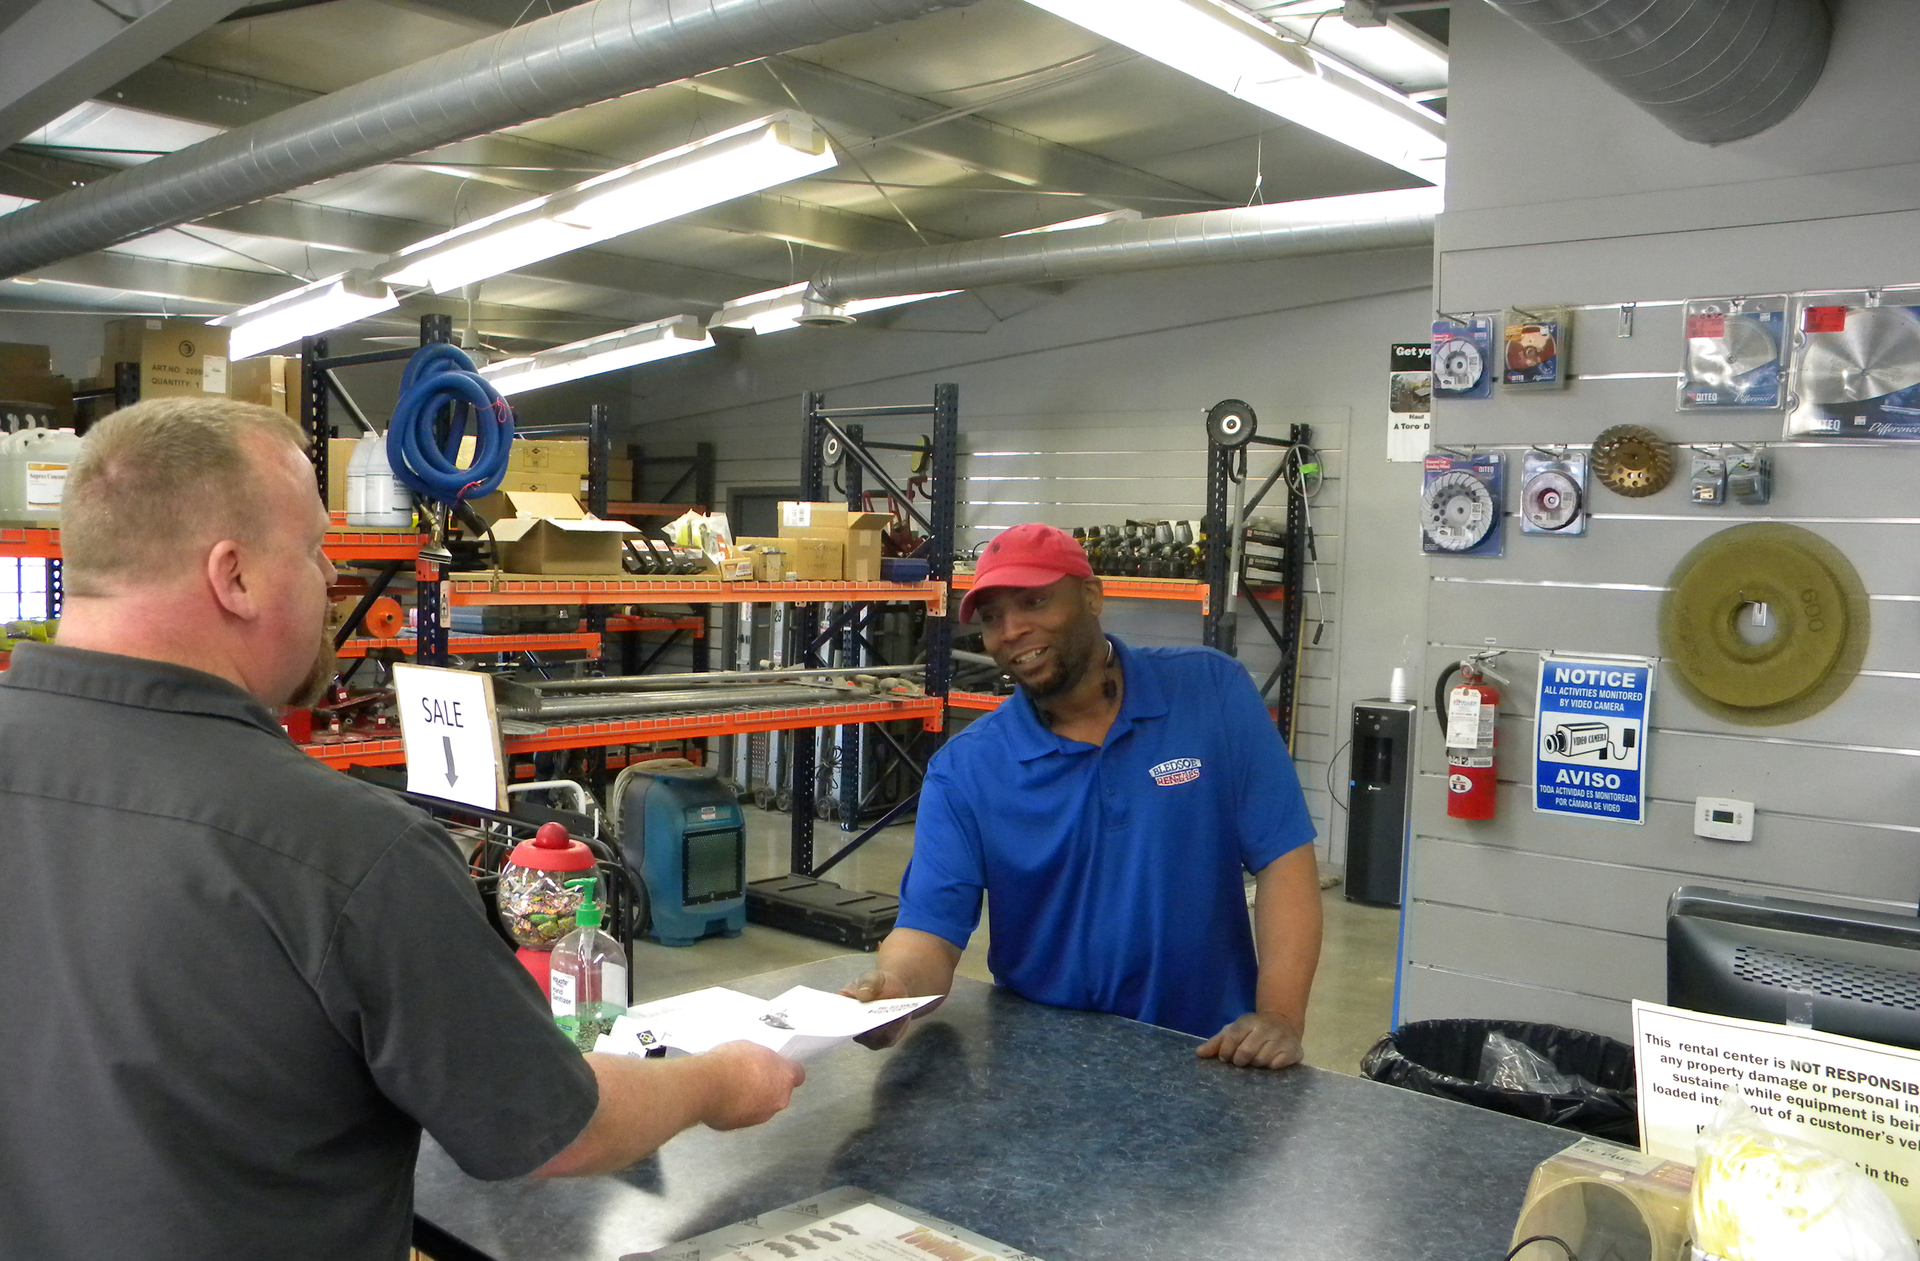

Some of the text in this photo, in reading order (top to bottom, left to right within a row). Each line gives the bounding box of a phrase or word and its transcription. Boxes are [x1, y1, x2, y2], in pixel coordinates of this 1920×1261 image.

[1396, 346, 1417, 356] Get
[151, 377, 192, 388] QUANTITY:
[1696, 393, 1717, 401] DITEQ
[1734, 394, 1776, 404] Difference!
[1555, 668, 1636, 688] NOTICE
[1544, 686, 1642, 701] ALL ACTIVITIES MONITORED
[422, 697, 464, 728] SALE
[1560, 698, 1625, 711] BY VIDEO CAMERA
[1573, 734, 1606, 746] VIDEO CAMERA
[1152, 759, 1197, 775] BLEDSOE
[1157, 770, 1199, 784] RENTALS
[1556, 769, 1621, 789] AVISO
[1540, 785, 1637, 803] TODA ACTIVIDAD ES MONITOREADA
[1555, 798, 1620, 812] POR CÁMARA DE VIDEO
[1645, 1033, 1920, 1096] This rental center is NOT RESPONSIB
[1660, 1055, 1920, 1118] any property damage or personal in
[1653, 1082, 1696, 1102] loaded
[1750, 1105, 1774, 1117] out
[1778, 1110, 1792, 1120] of
[1796, 1114, 1805, 1124] a
[1810, 1117, 1894, 1145] customer’s
[1744, 1087, 1781, 1101] while
[1786, 1095, 1867, 1121] equipment
[1872, 1111, 1885, 1124] is
[1865, 1164, 1879, 1179] in
[1883, 1170, 1909, 1187] the
